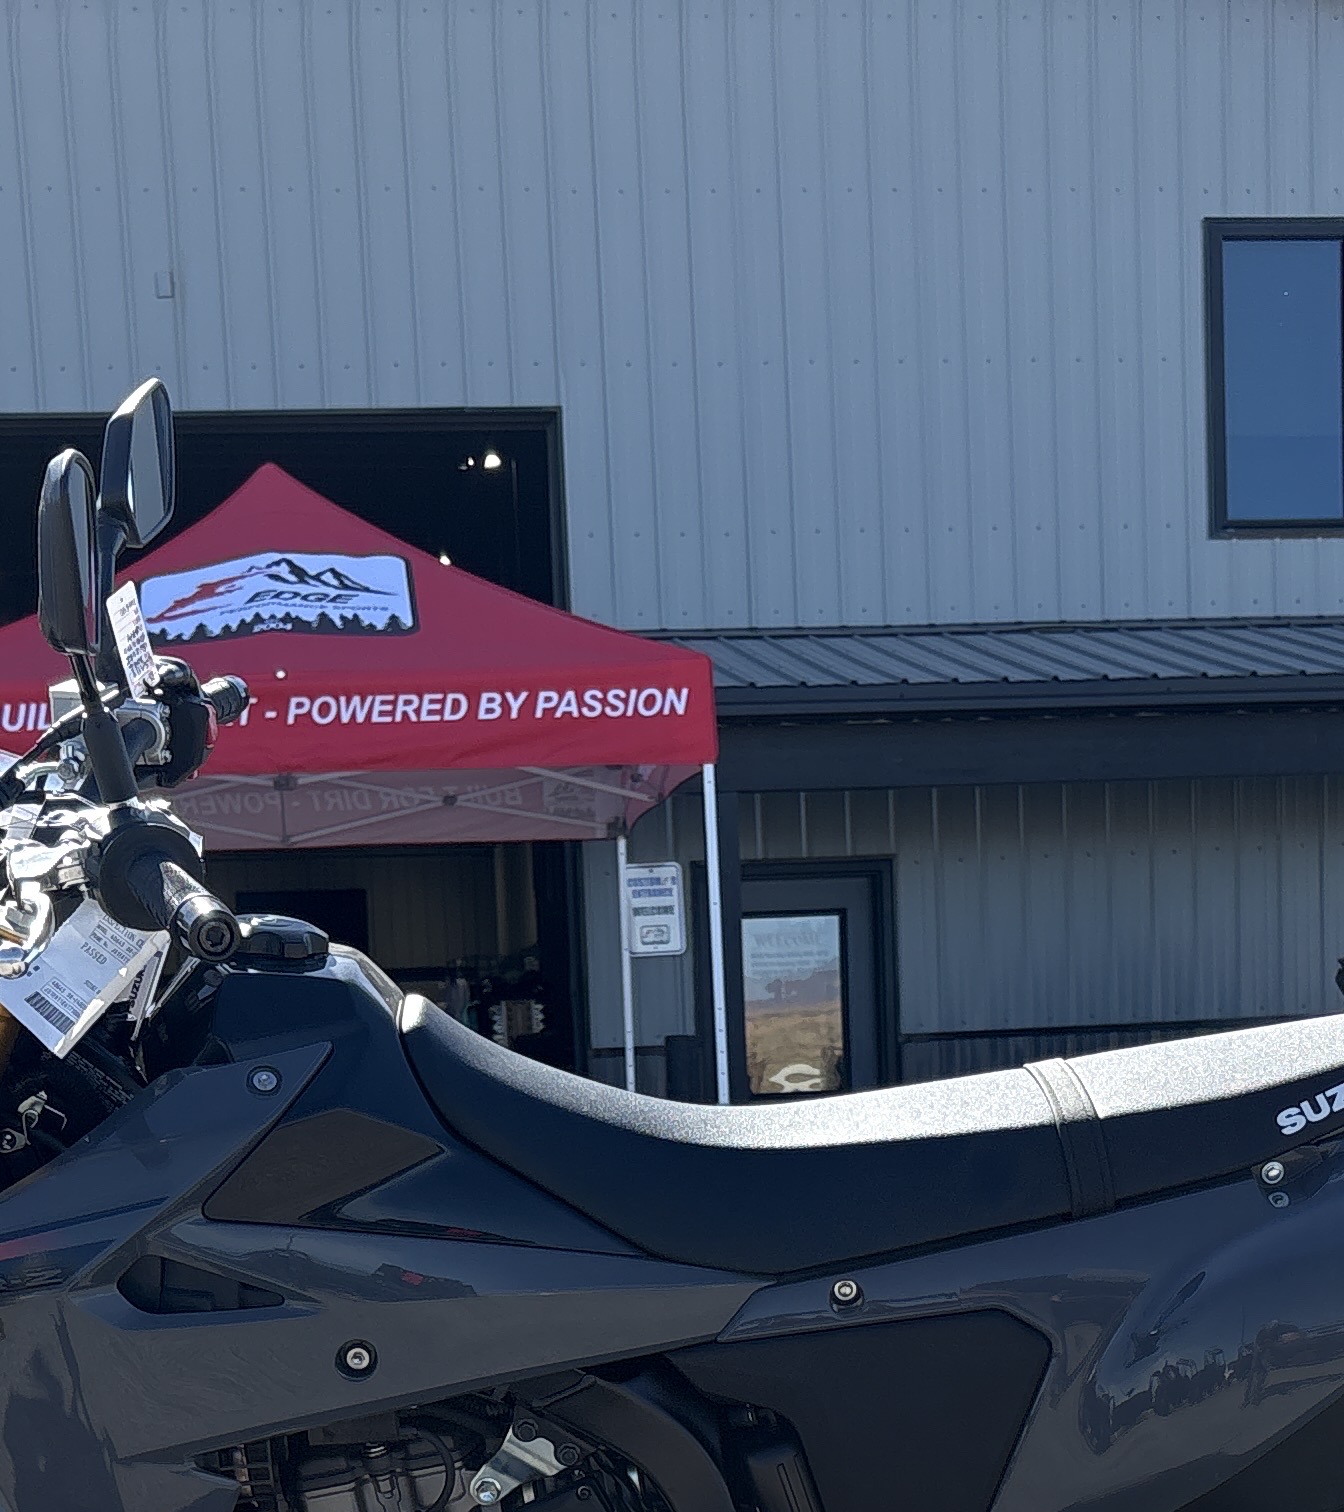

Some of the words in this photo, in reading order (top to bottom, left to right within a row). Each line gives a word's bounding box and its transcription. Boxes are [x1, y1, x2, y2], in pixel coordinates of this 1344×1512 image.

[244, 589, 360, 605] EDGE
[287, 692, 468, 726] POWERED
[477, 691, 530, 721] BY
[535, 687, 689, 720] PASSION
[80, 941, 108, 965] PASSED
